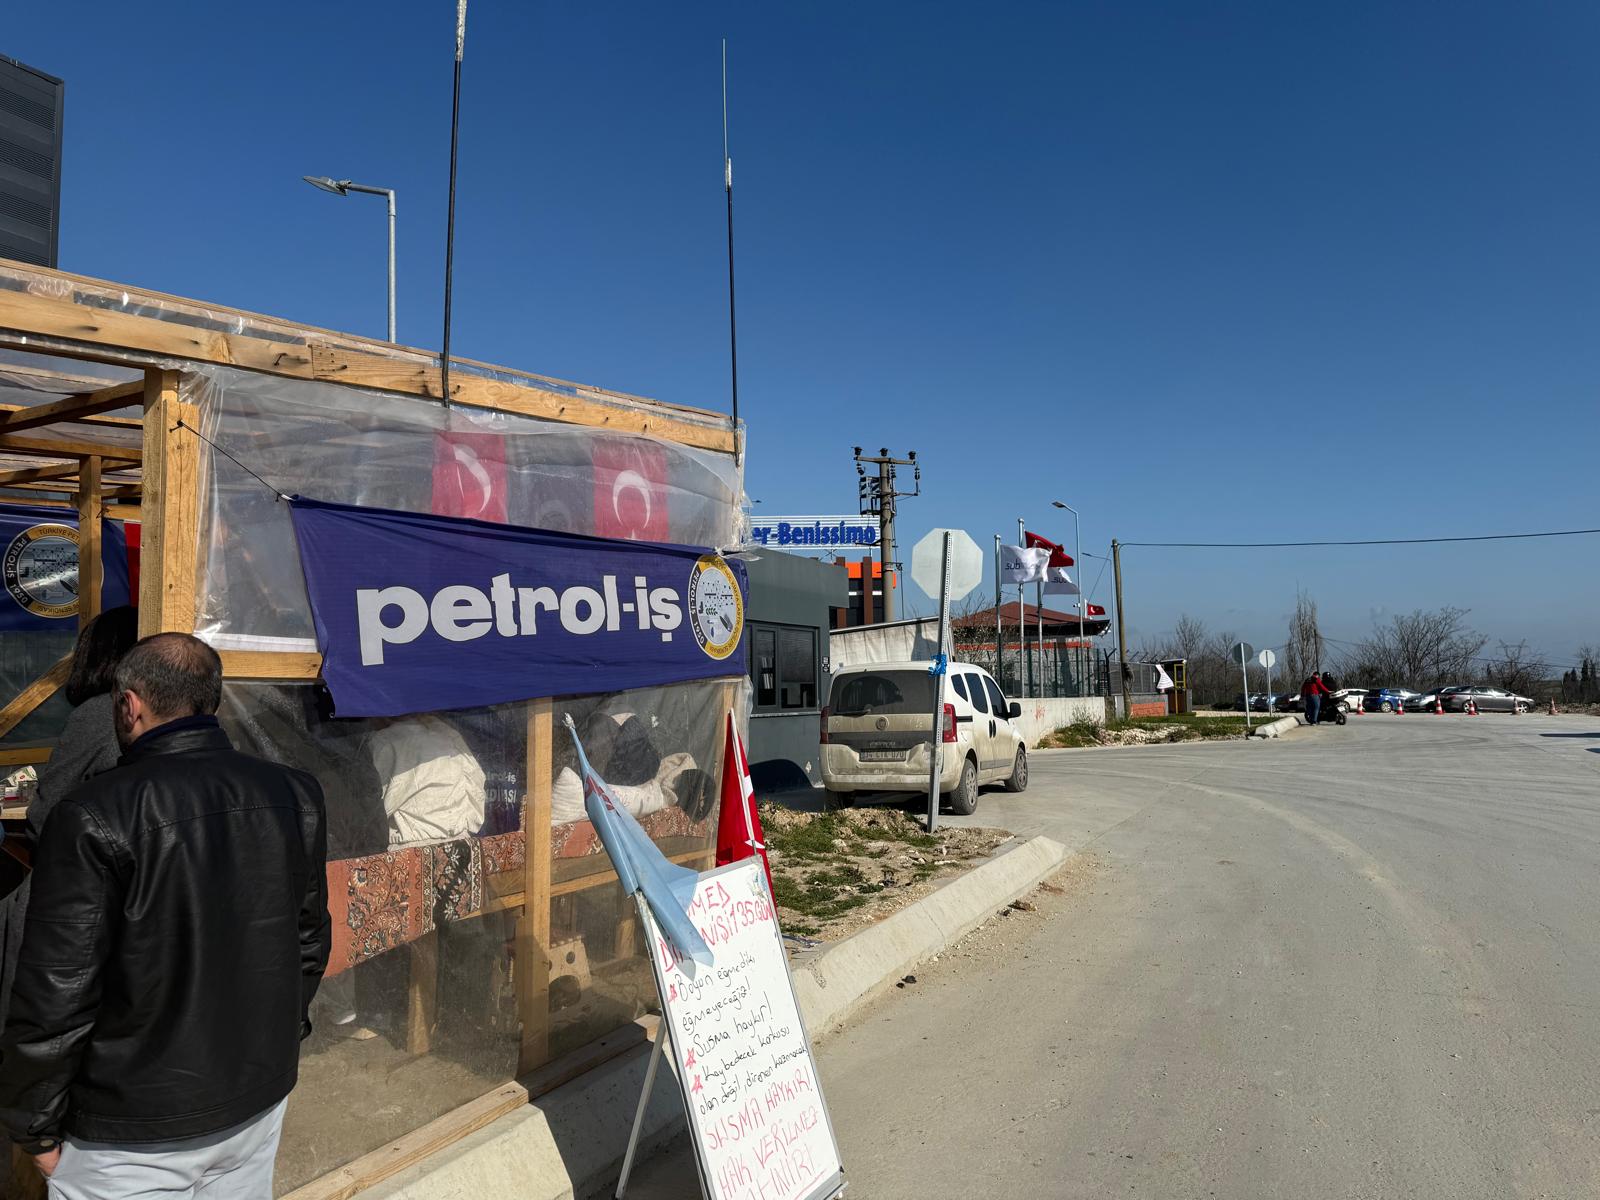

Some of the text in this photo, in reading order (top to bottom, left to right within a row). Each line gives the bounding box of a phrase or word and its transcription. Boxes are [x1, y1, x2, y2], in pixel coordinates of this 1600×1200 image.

[752, 520, 876, 546] er-Benissimo
[9, 583, 28, 604] 1950
[356, 573, 682, 666] petrol-iş
[675, 974, 714, 1001] Boyun
[693, 1031, 731, 1058] Susma
[705, 1065, 813, 1150] SUSMA HAYKIR!
